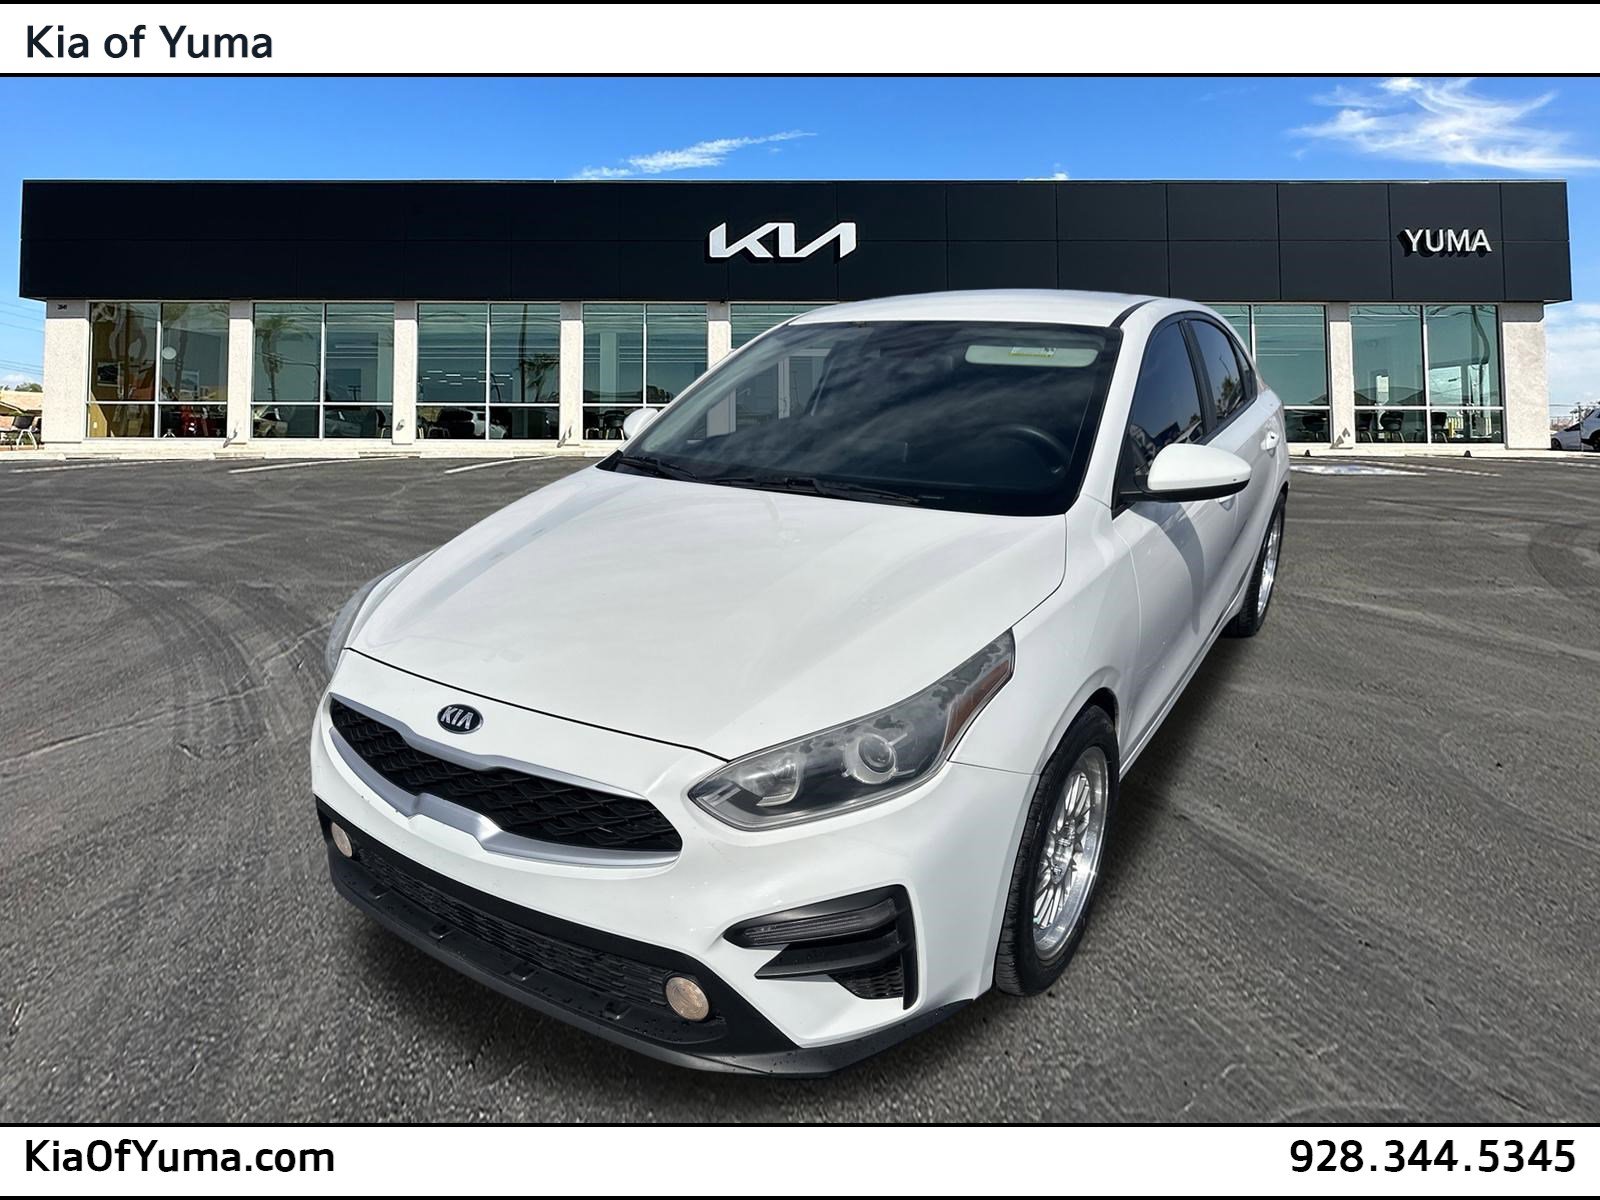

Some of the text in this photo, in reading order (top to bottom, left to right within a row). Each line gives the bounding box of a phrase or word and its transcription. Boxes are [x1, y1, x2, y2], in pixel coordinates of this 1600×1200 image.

[708, 221, 857, 259] KIA
[1403, 228, 1493, 254] YUMA
[440, 706, 474, 730] KIA
